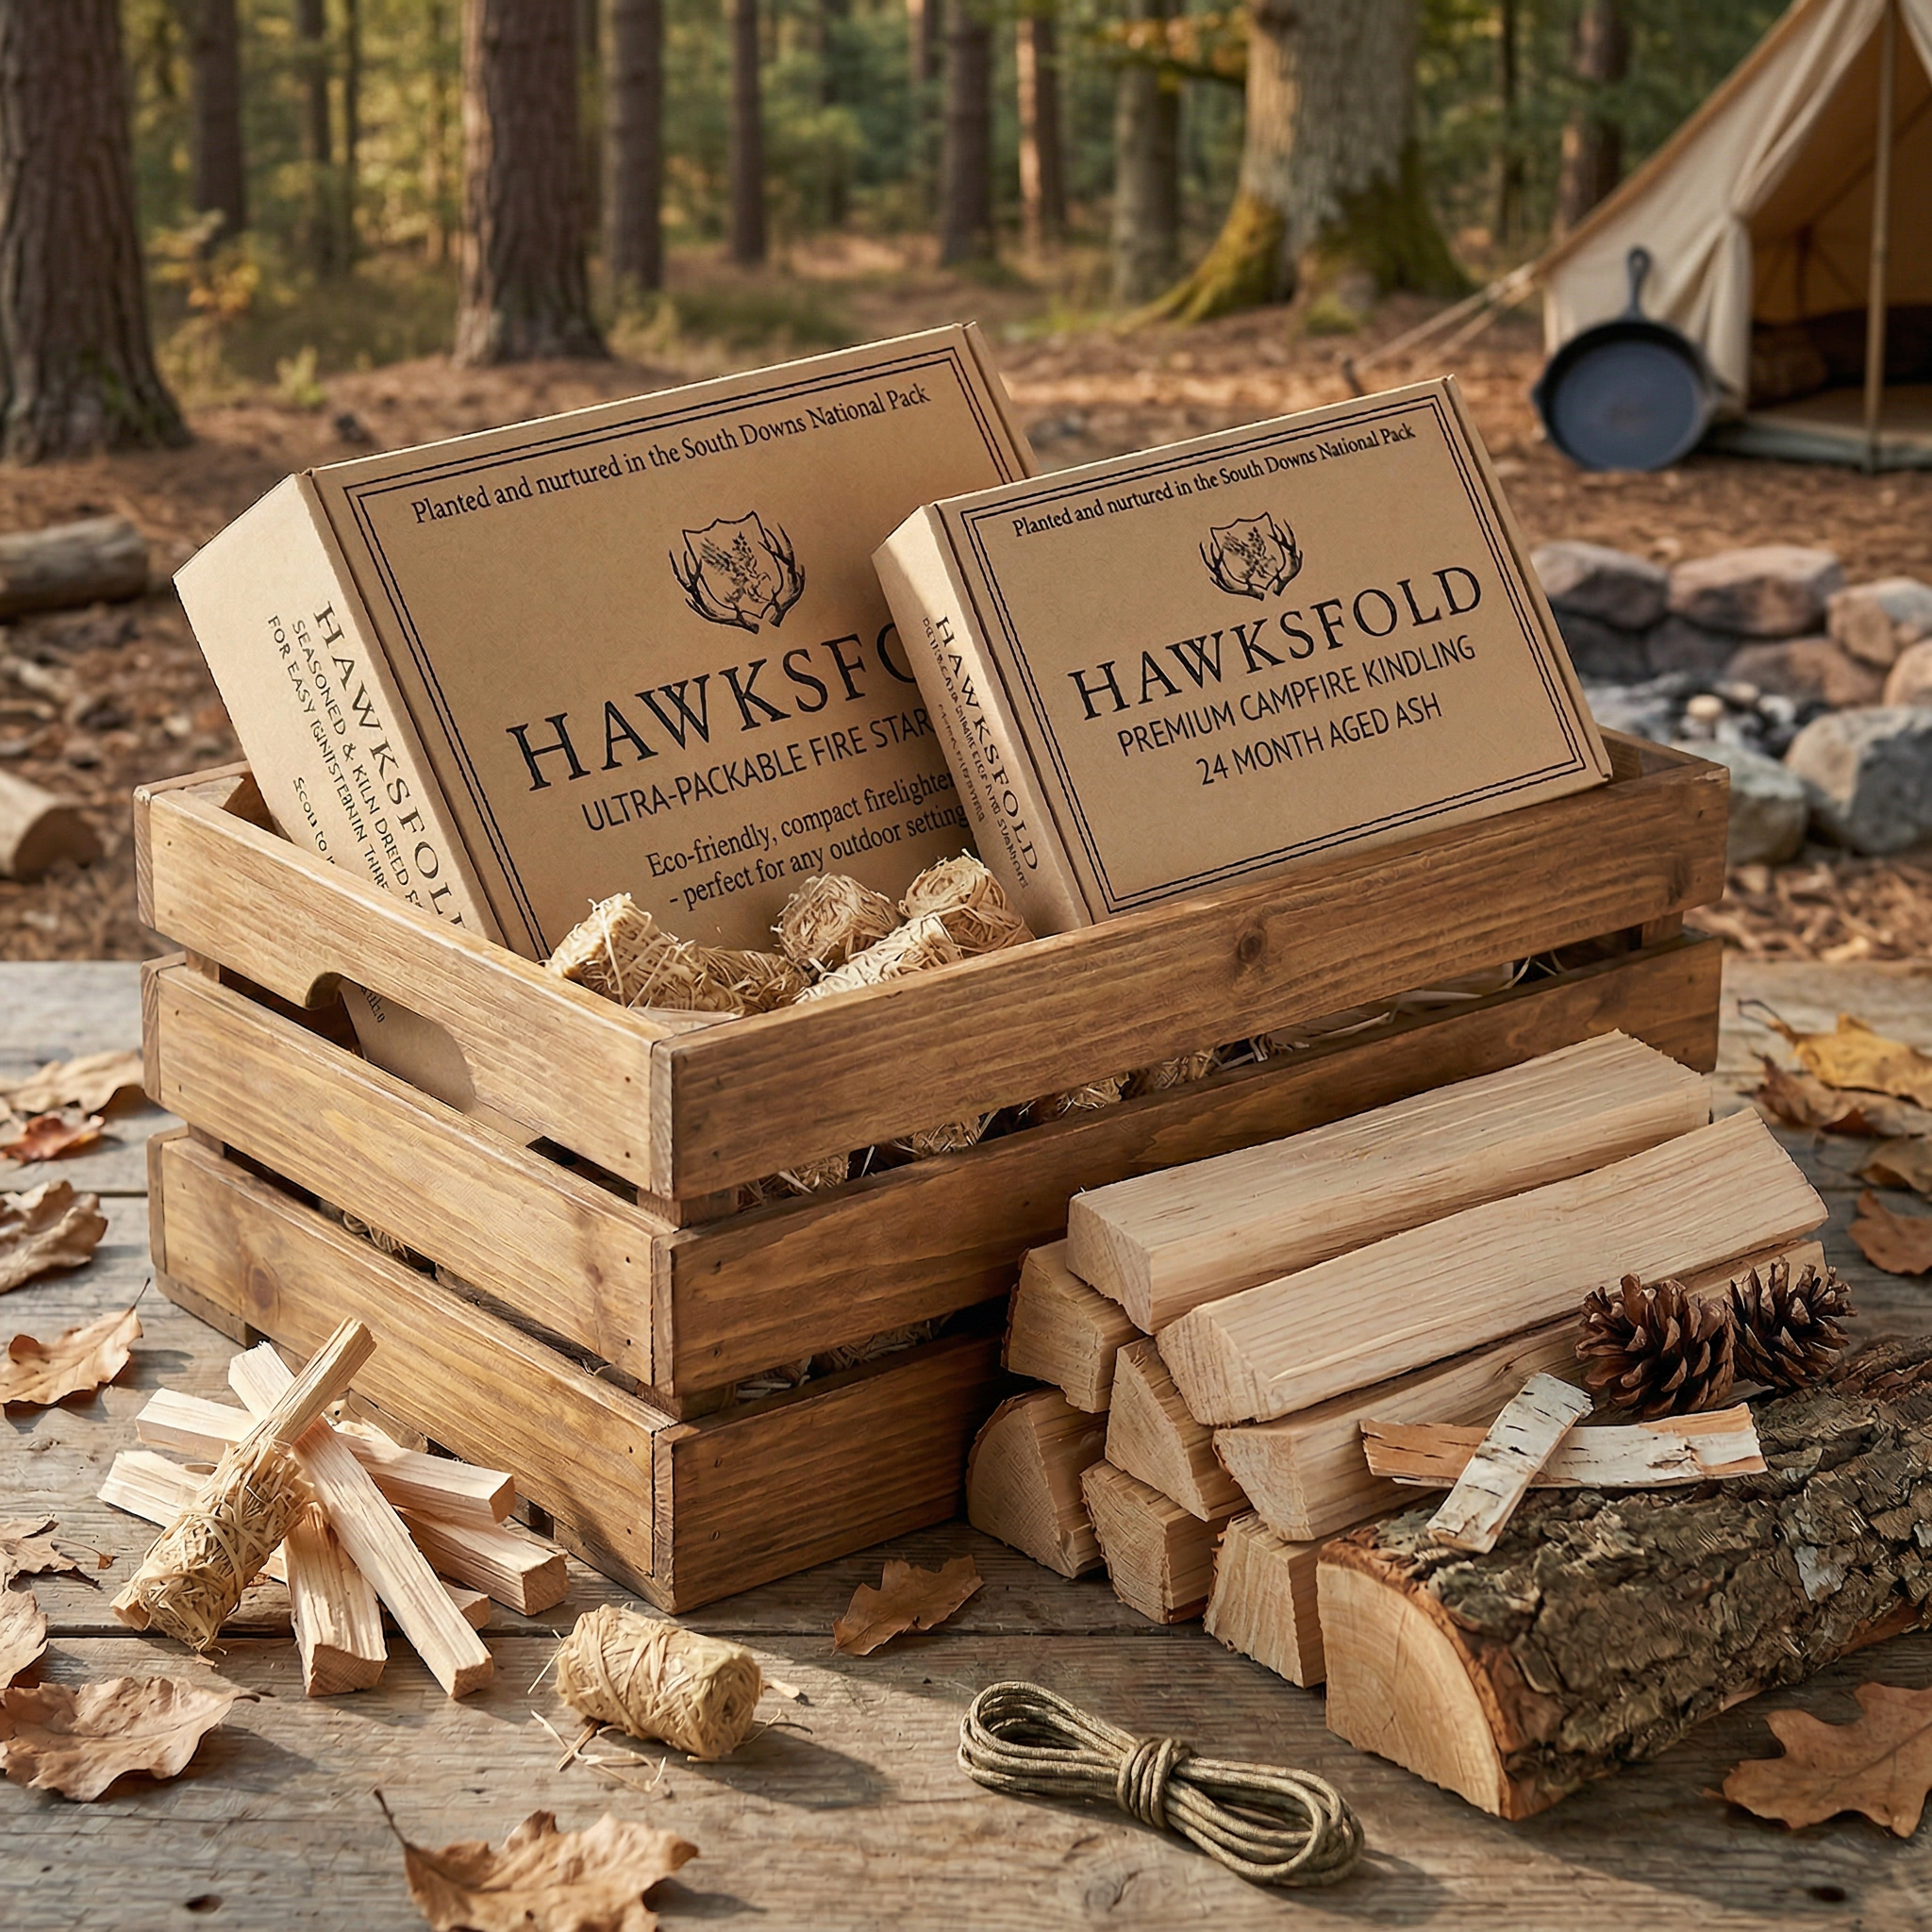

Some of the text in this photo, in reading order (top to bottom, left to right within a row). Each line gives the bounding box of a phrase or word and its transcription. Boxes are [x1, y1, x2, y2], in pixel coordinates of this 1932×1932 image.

[410, 383, 931, 524] Planted and nurtured in the South Downs National Pack
[1012, 423, 1416, 538] Planted and nurtured in the South Downs National Pack
[268, 615, 291, 659] FOR
[287, 661, 315, 713] EASY
[1067, 567, 1481, 721] HAWKSFOLD
[1117, 635, 1475, 757] PREMIUM CAMPFIRE KINDLING
[291, 620, 345, 736] SEASONED
[342, 742, 357, 762] &
[353, 764, 380, 815] KILN
[581, 708, 936, 831] ULTRA-PACKABLE FIRE STAR
[935, 616, 1039, 871] HAWKSFOLD
[1196, 691, 1442, 785] 24 MONTH AGED ASH
[644, 824, 778, 877] Eco-friendly,
[780, 797, 862, 838] compact
[683, 866, 755, 911] perfect
[755, 859, 786, 884] for
[790, 852, 824, 878] any
[829, 822, 902, 860] outdoor
